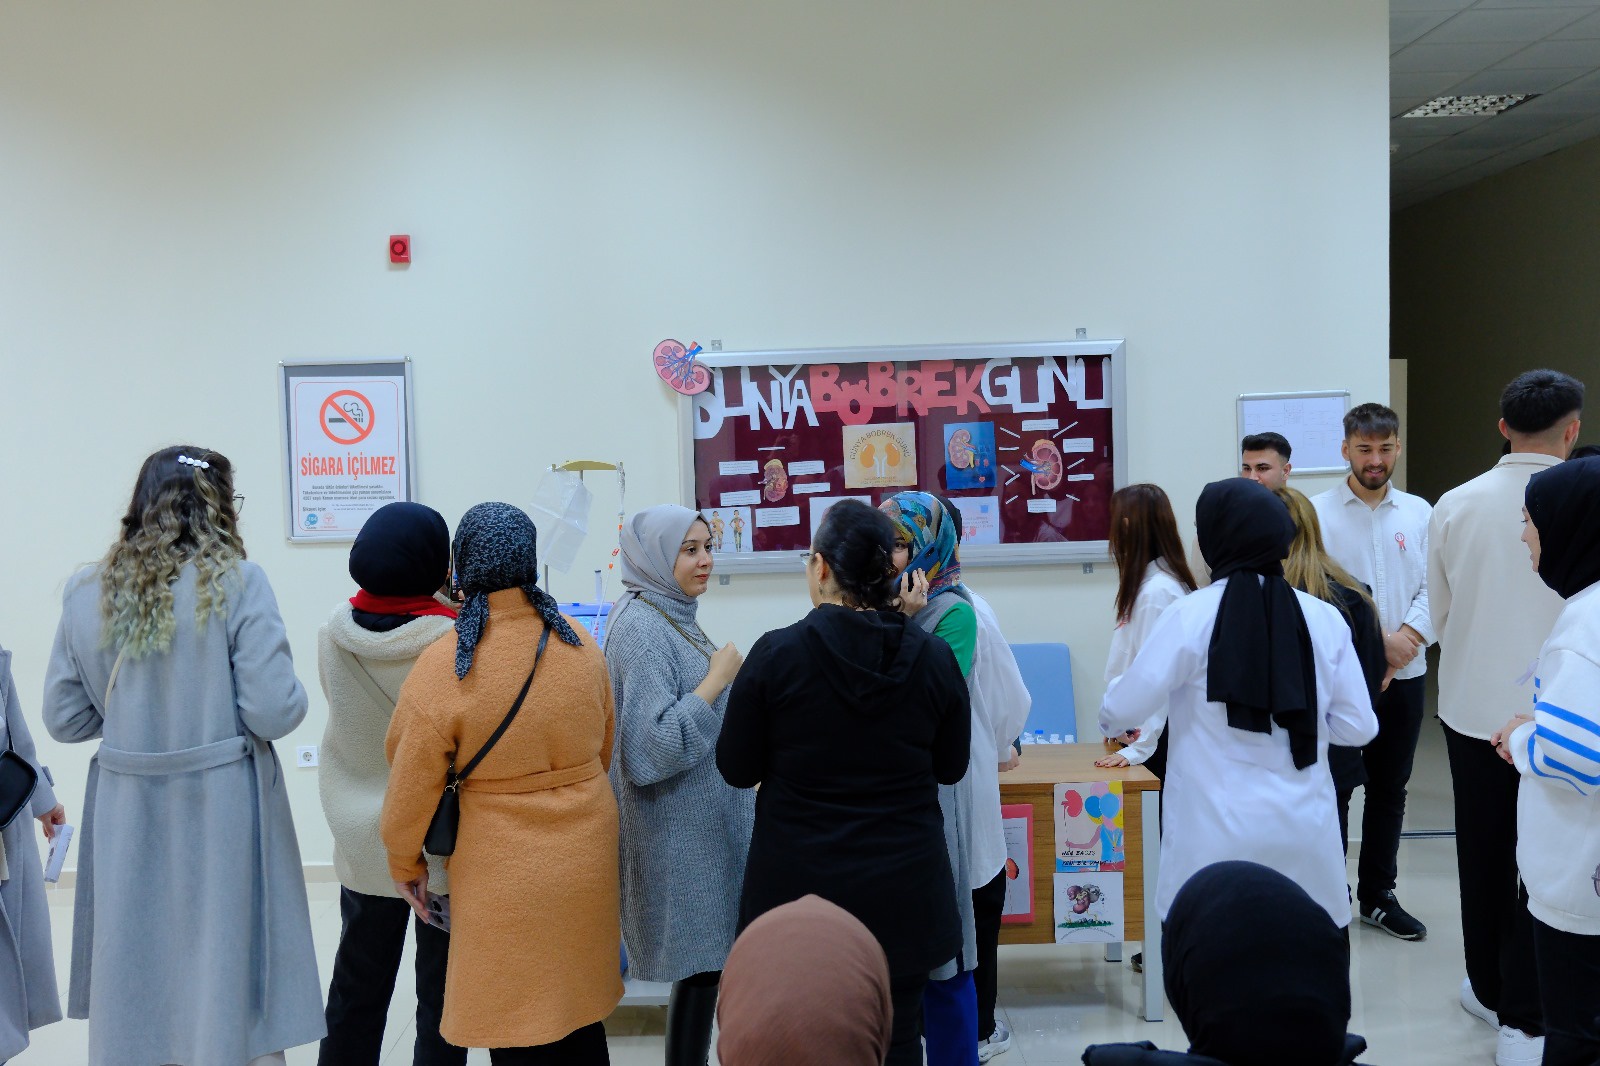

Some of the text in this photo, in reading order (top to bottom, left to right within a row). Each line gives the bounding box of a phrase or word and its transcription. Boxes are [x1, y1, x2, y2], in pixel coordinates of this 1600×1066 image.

[809, 359, 992, 425] BÖBREK
[301, 451, 396, 480] SİGARA İÇİLMEZ
